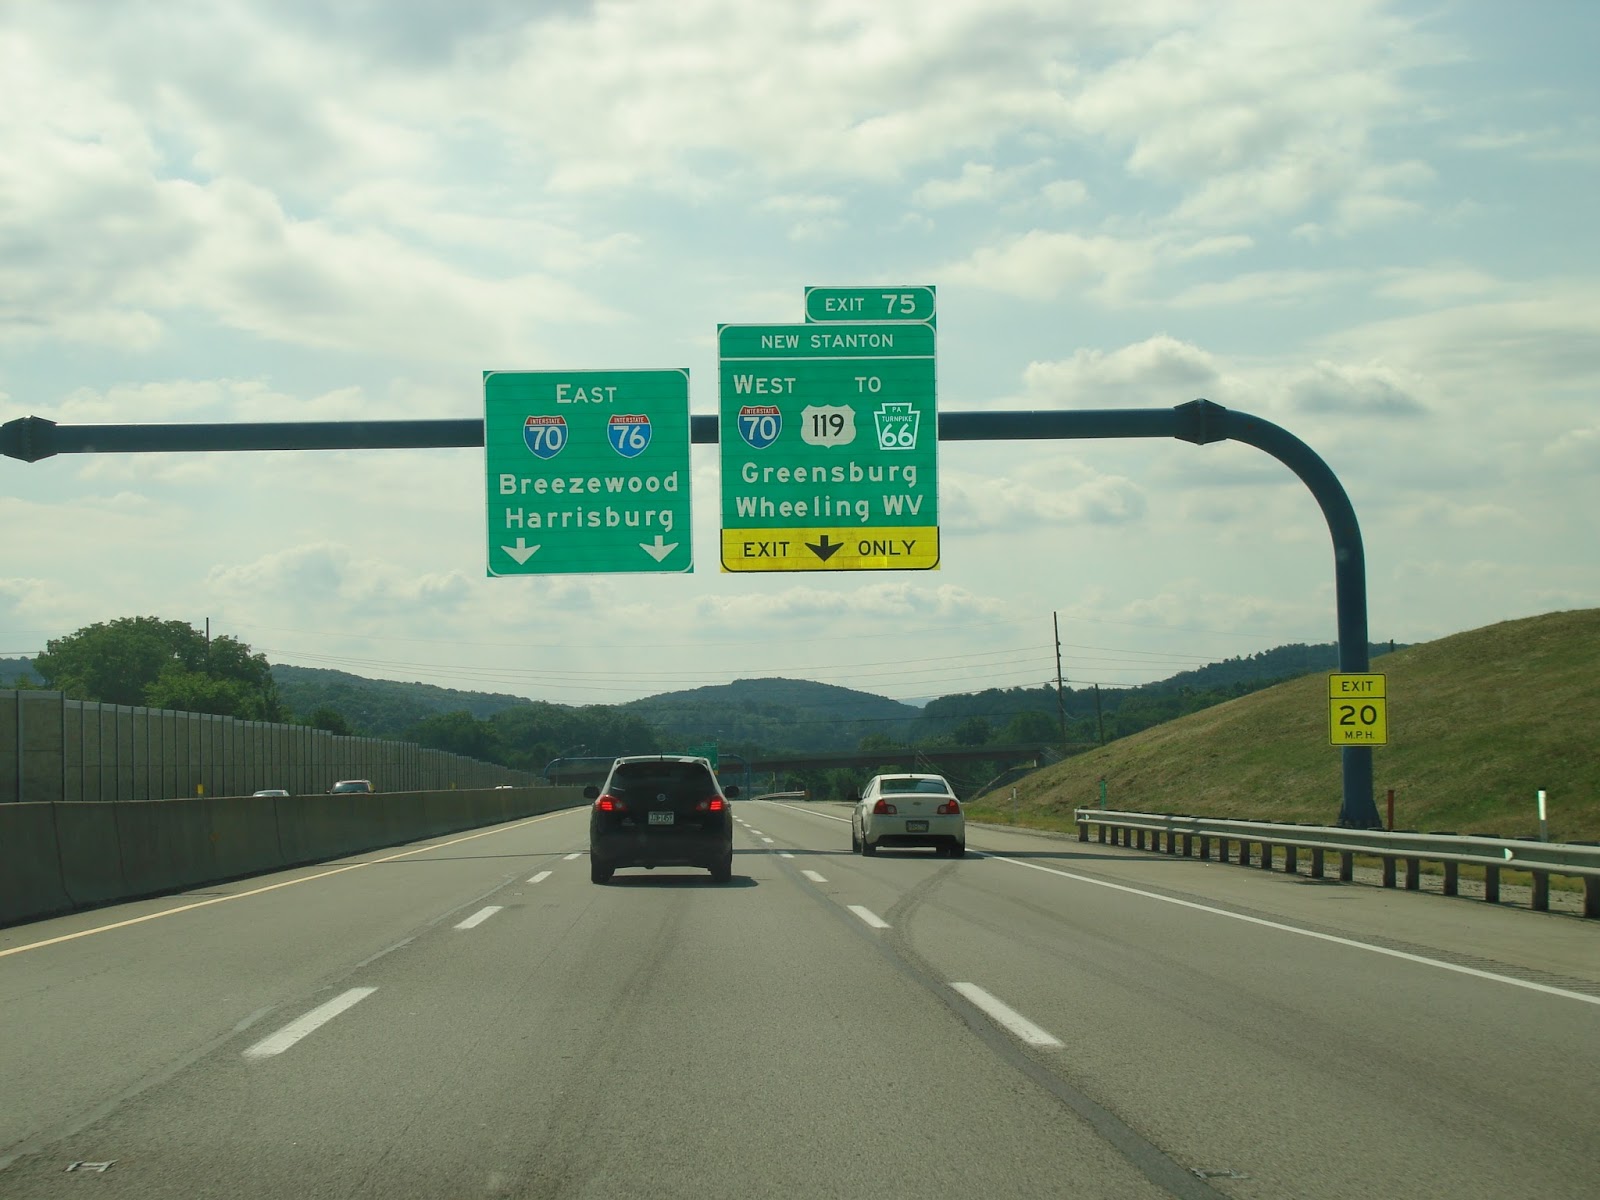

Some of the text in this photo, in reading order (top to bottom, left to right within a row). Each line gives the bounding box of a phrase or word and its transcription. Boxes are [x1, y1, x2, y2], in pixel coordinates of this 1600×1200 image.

[825, 294, 916, 314] EXIT 75
[761, 334, 893, 349] NEW STANTON
[556, 384, 617, 404] EAST
[733, 374, 796, 394] WEST
[855, 377, 881, 392] TO
[530, 417, 561, 425] INTERSTATE
[614, 416, 645, 424] INTERSTATE
[744, 407, 775, 415] INTERSTATE
[743, 416, 776, 440] 70
[812, 413, 845, 437] 119
[881, 423, 914, 447] 66
[529, 427, 563, 450] 70
[613, 426, 646, 449] 76
[500, 471, 678, 495] Breezewood
[741, 462, 917, 488] Greensburg
[735, 495, 924, 523] Wheeling WV
[506, 506, 673, 533] Harrisburg
[743, 540, 916, 558] EXIT ONLY
[1341, 681, 1374, 692] EXIT
[1339, 705, 1377, 726] 20
